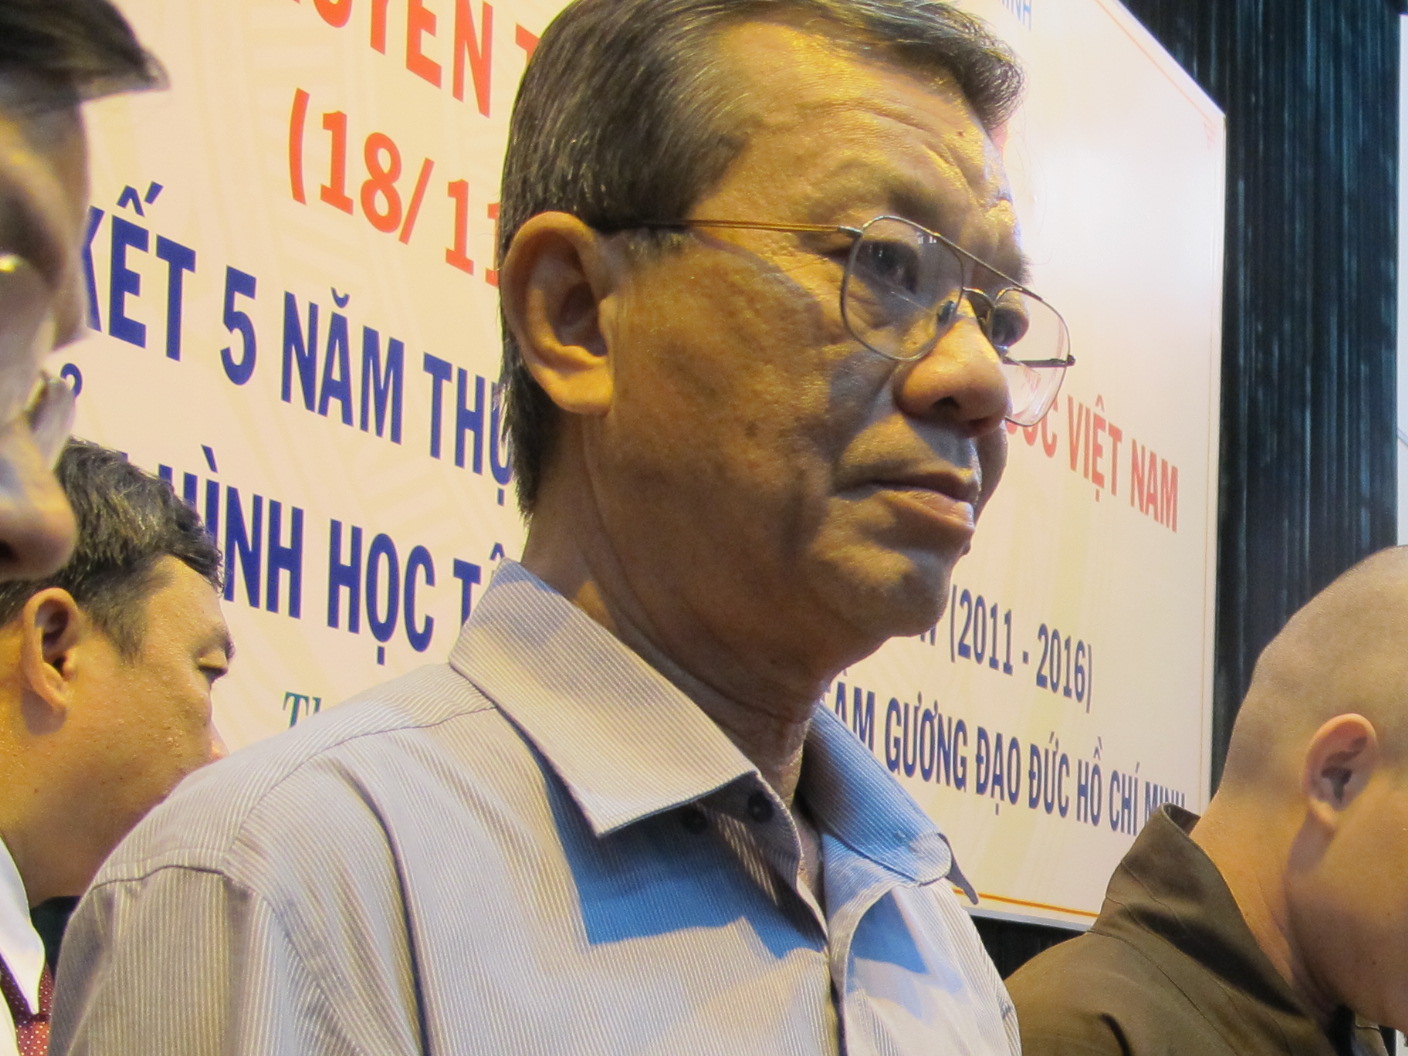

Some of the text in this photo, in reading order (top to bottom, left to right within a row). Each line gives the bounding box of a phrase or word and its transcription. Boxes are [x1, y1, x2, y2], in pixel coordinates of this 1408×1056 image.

[220, 265, 257, 386] 5
[280, 287, 404, 444] NĂM
[1068, 394, 1122, 503] VIỆT
[1130, 438, 1178, 533] NAM
[158, 444, 304, 620] ÌNH
[327, 518, 436, 665] HỌC
[950, 584, 1014, 676] (2011
[1036, 623, 1092, 713] 2016)
[885, 691, 968, 793] GƯƠNG
[975, 726, 1021, 815] ĐẠO
[1028, 731, 1070, 818] ĐỨC
[1077, 736, 1103, 827] HỒ
[1109, 761, 1140, 836] CHÍ
